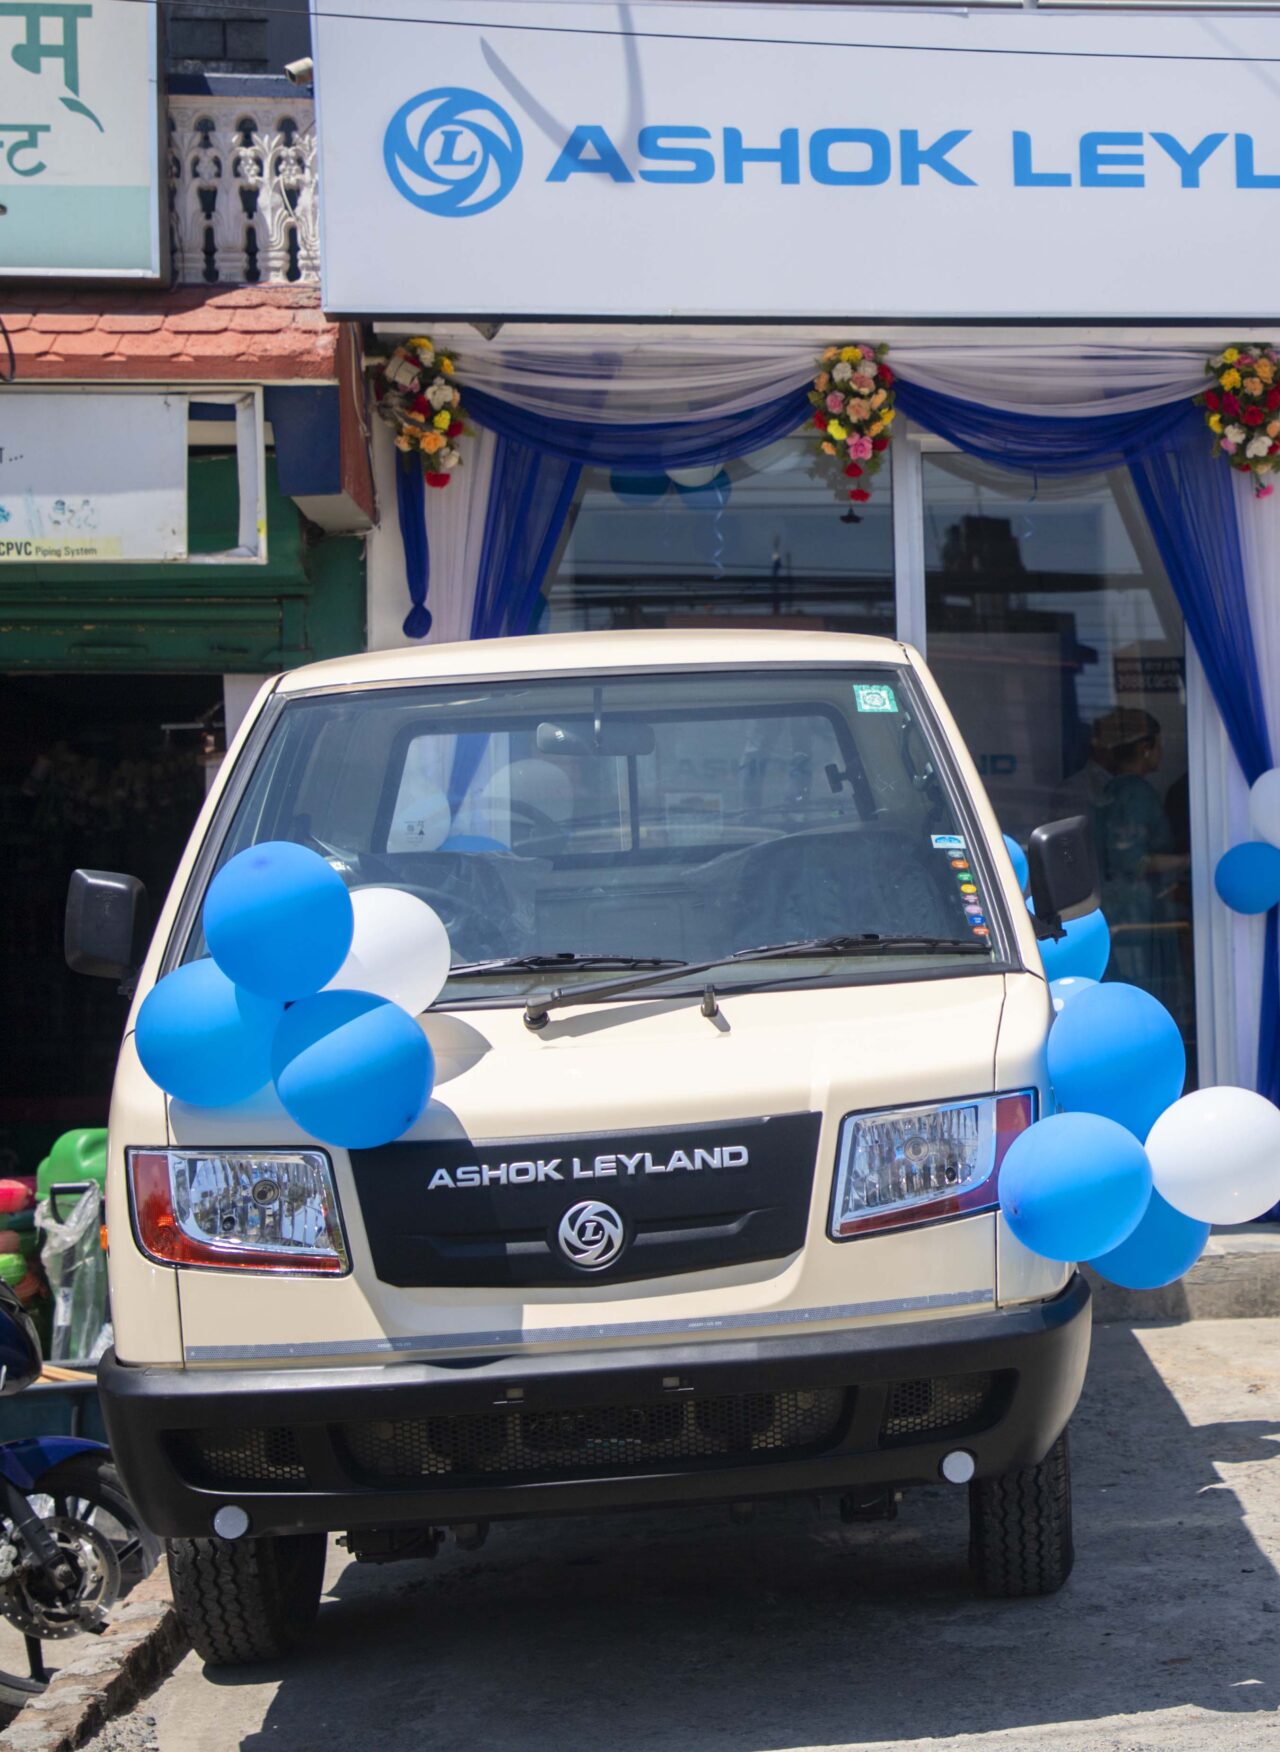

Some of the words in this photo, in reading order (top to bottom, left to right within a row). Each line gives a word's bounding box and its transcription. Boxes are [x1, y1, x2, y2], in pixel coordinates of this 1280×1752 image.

[433, 130, 477, 165] L
[545, 125, 977, 187] ASHOK
[64, 545, 97, 558] System
[427, 1158, 564, 1190] ASHOK
[573, 1145, 749, 1178] LEYLAND
